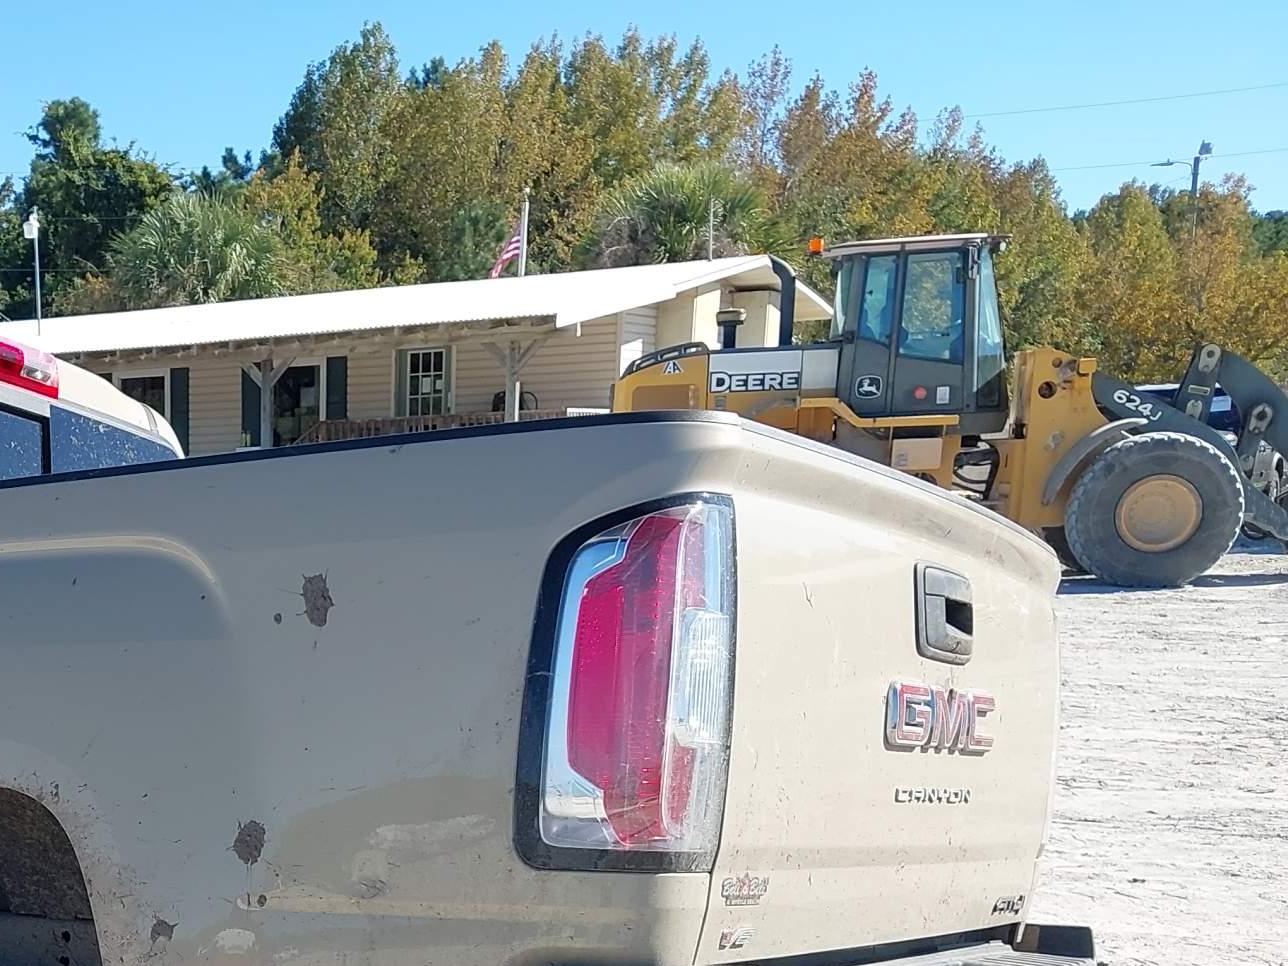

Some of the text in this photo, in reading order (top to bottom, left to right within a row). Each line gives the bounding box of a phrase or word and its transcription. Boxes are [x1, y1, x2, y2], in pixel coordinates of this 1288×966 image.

[710, 371, 800, 393] DEERE
[1113, 389, 1162, 421] 624J
[885, 680, 995, 753] GMC
[894, 787, 971, 804] CANYON
